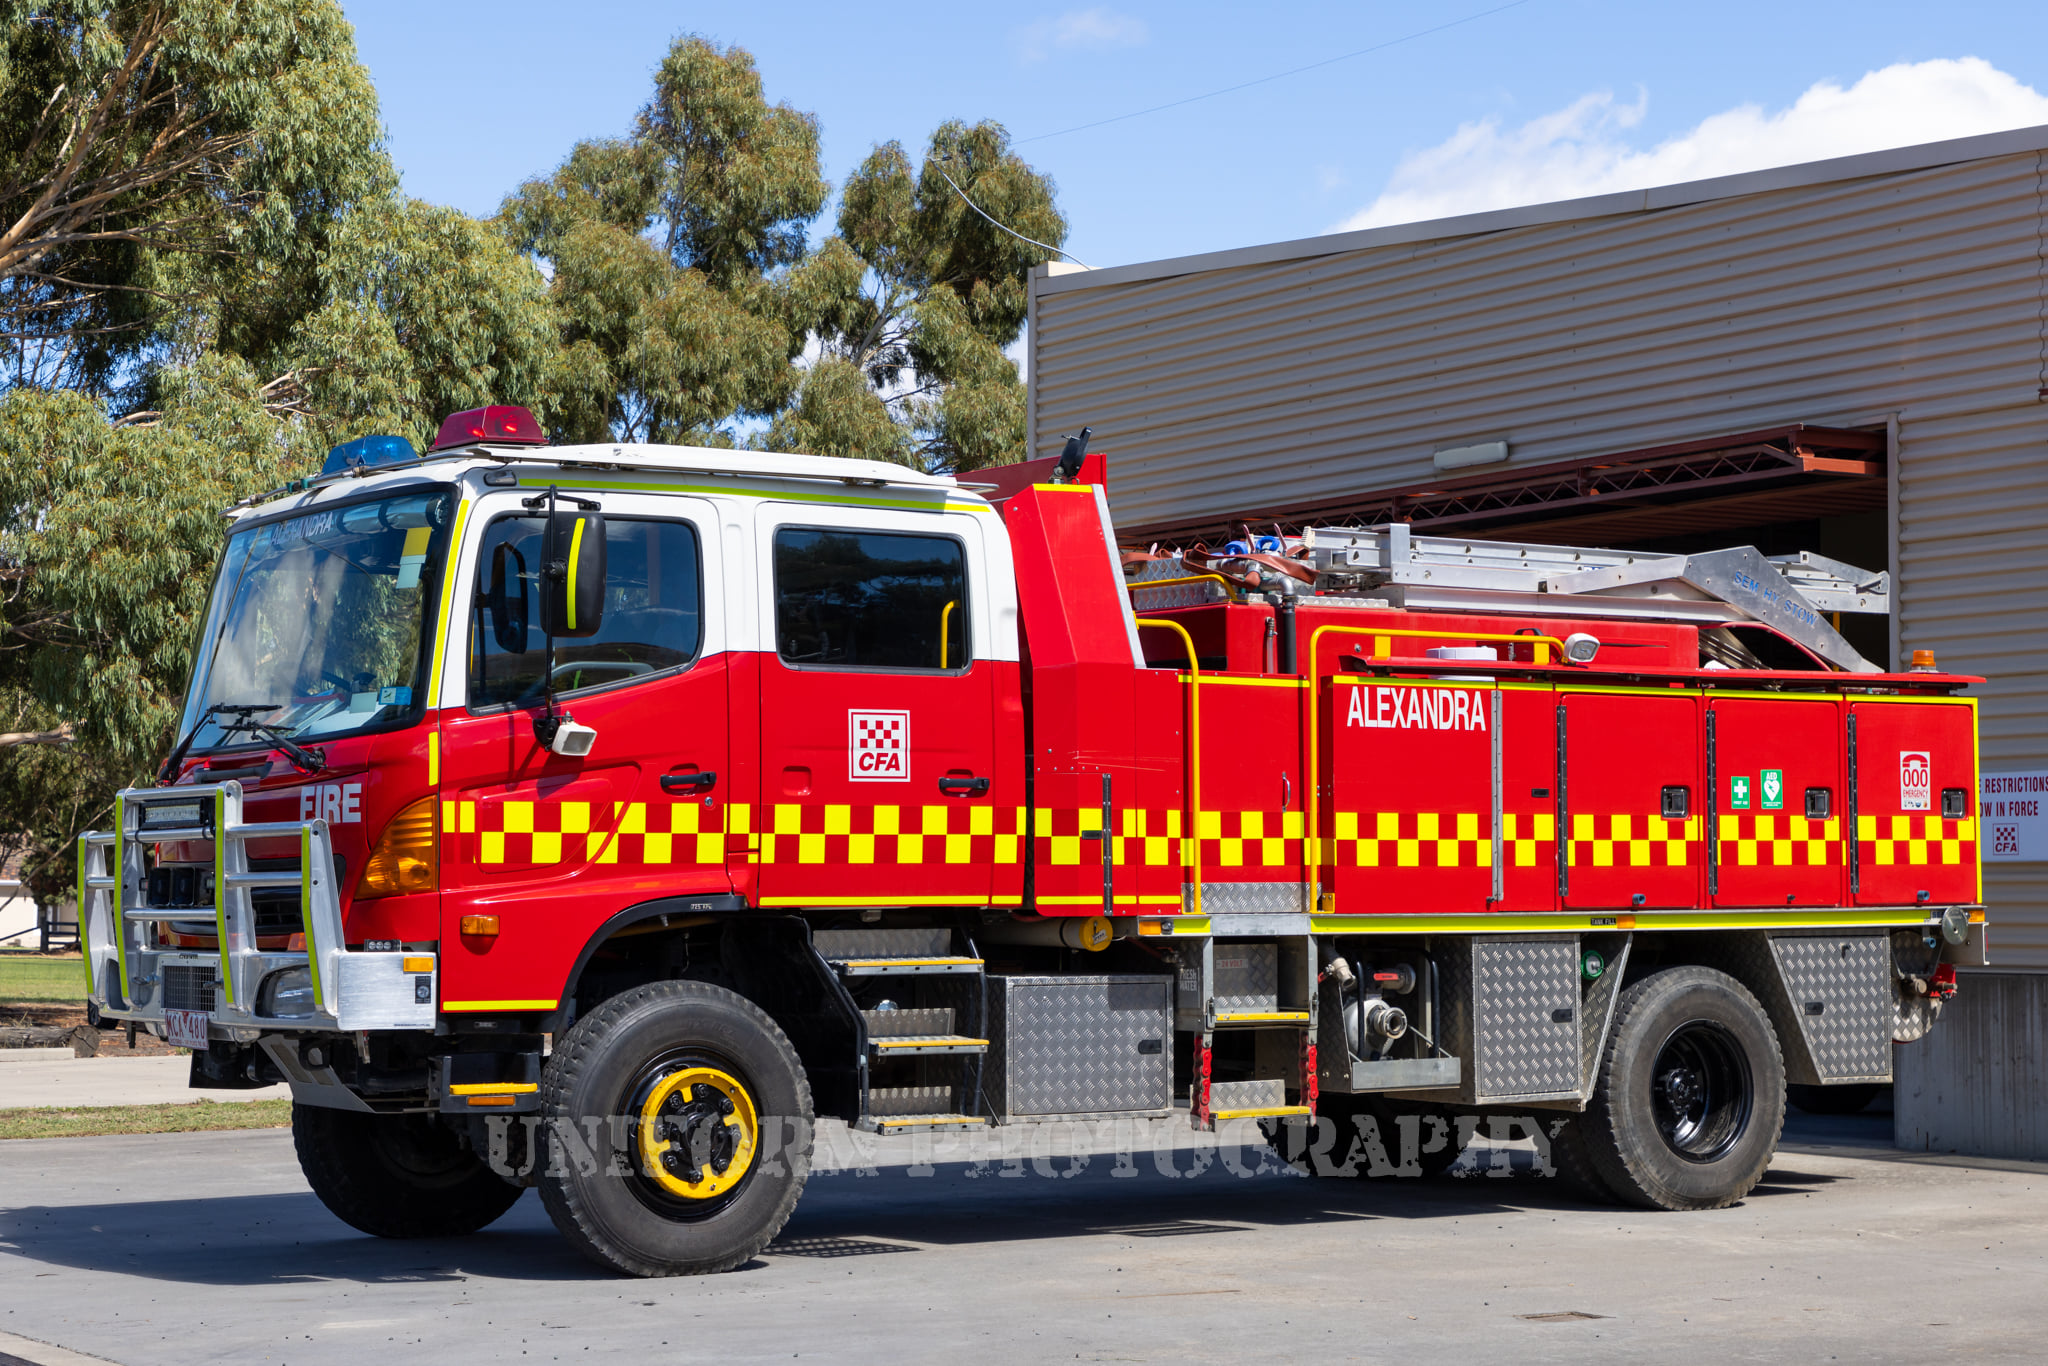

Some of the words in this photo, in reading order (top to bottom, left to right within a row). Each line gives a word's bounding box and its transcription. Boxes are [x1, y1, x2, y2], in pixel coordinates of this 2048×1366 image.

[1734, 571, 1760, 593] SEM
[1763, 587, 1780, 605] HY
[1784, 599, 1817, 625] STOW
[1347, 686, 1486, 731] ALEXANDRA
[858, 752, 900, 771] CFA
[1903, 789, 1928, 798] EMERGENCY
[300, 783, 362, 823] FIRE
[1980, 802, 1992, 817] OW
[1996, 802, 2005, 817] IN
[2009, 800, 2038, 816] FORCE
[1995, 842, 2017, 853] CFA
[1230, 960, 1243, 968] VOLT
[1180, 980, 1198, 992] WATER
[189, 1015, 205, 1040] 480
